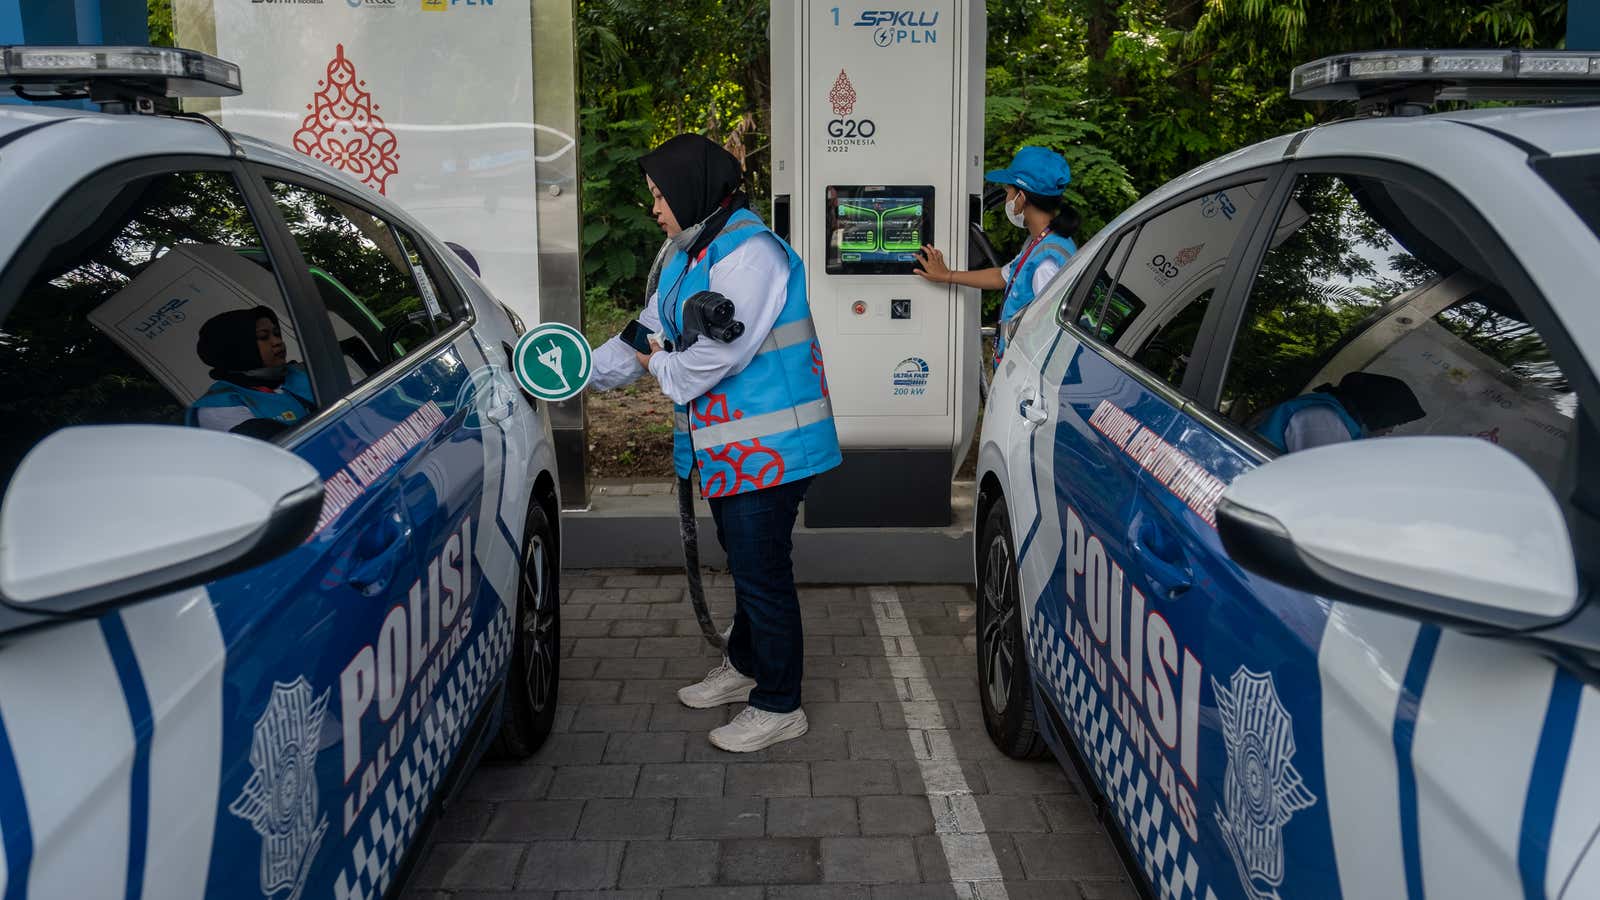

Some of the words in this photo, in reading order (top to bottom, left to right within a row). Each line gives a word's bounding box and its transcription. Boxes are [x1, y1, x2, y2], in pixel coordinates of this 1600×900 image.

[830, 7, 840, 26] 1
[853, 11, 939, 26] SPKLU
[896, 30, 937, 44] PLN
[827, 119, 876, 138] G20
[893, 387, 909, 396] 200
[910, 387, 926, 396] kW
[347, 430, 408, 488] MENGAYOMI
[393, 419, 421, 451] DAN
[340, 515, 471, 784] POLISI
[1066, 505, 1202, 789] POLISI
[344, 711, 405, 836] LALU
[410, 605, 473, 726] LINTAS
[1065, 606, 1108, 693] LALU
[1112, 675, 1199, 844] LINTAS
